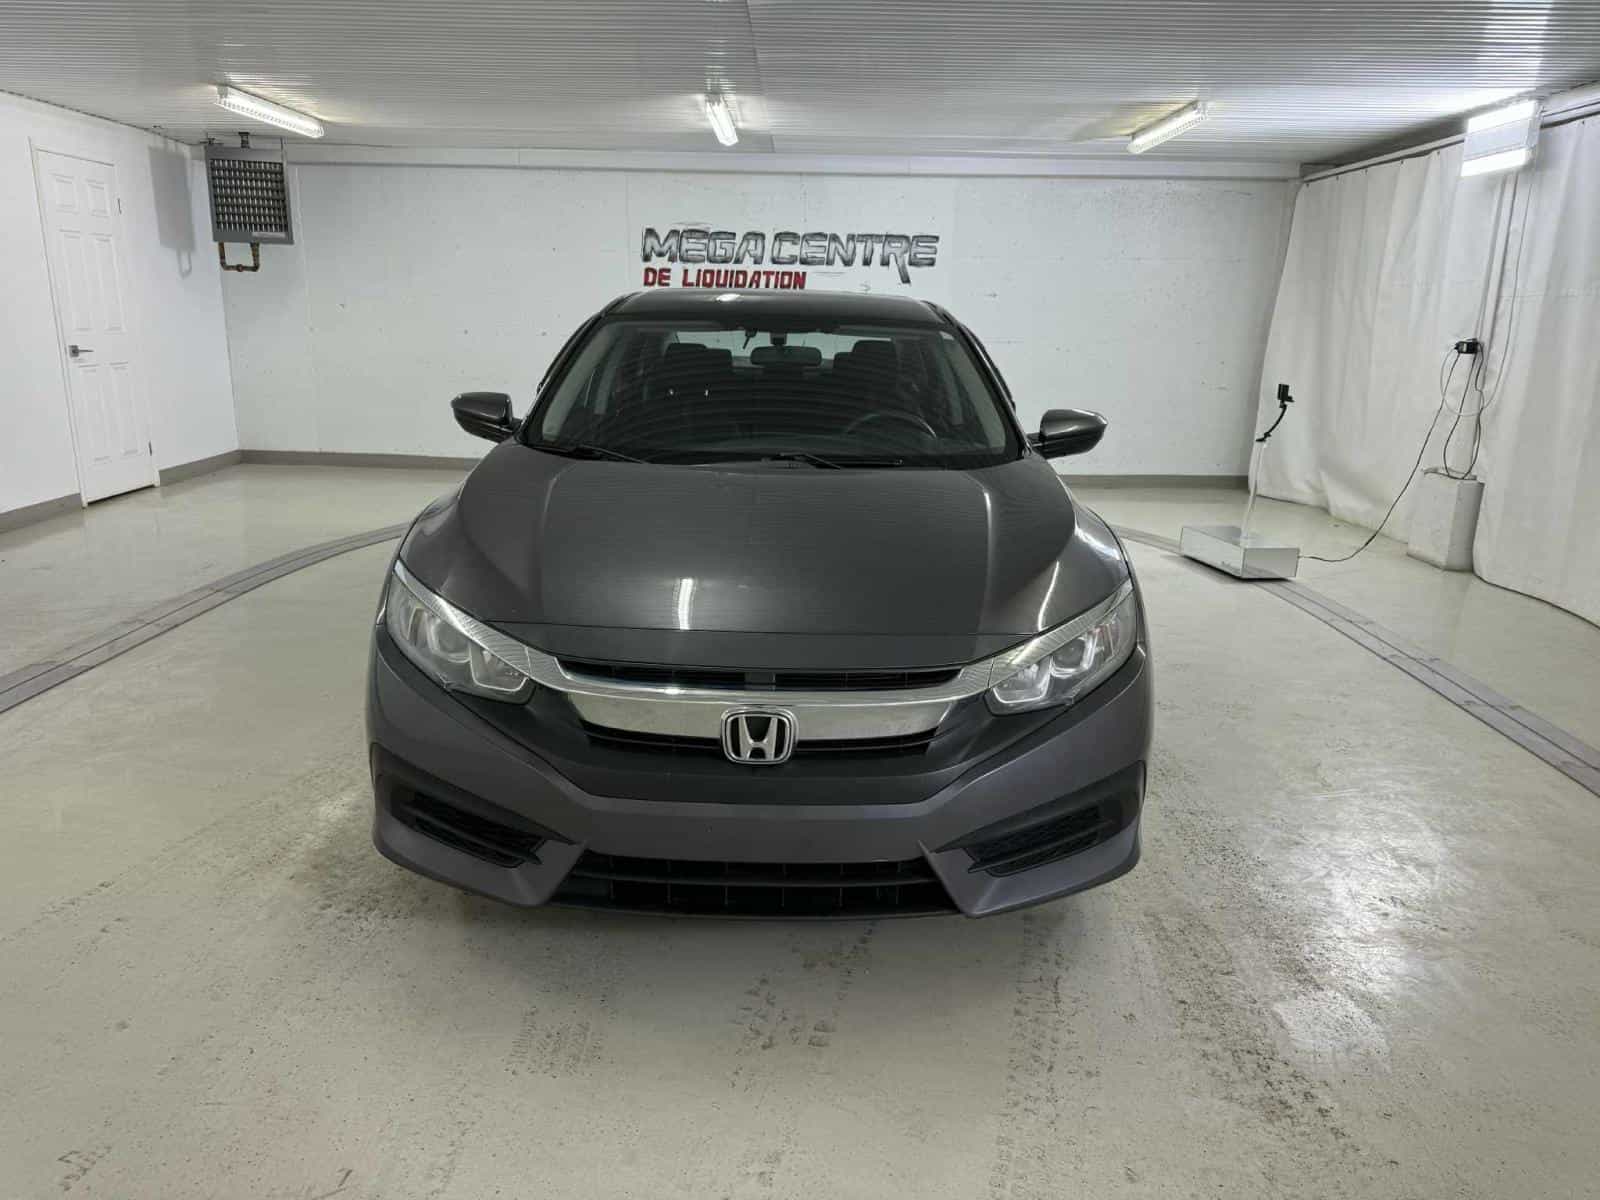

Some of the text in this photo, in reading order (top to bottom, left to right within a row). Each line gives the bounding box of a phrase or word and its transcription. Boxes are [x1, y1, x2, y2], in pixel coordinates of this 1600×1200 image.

[771, 231, 940, 284] CENTRE
[643, 267, 807, 289] DE LIQUIDATION
